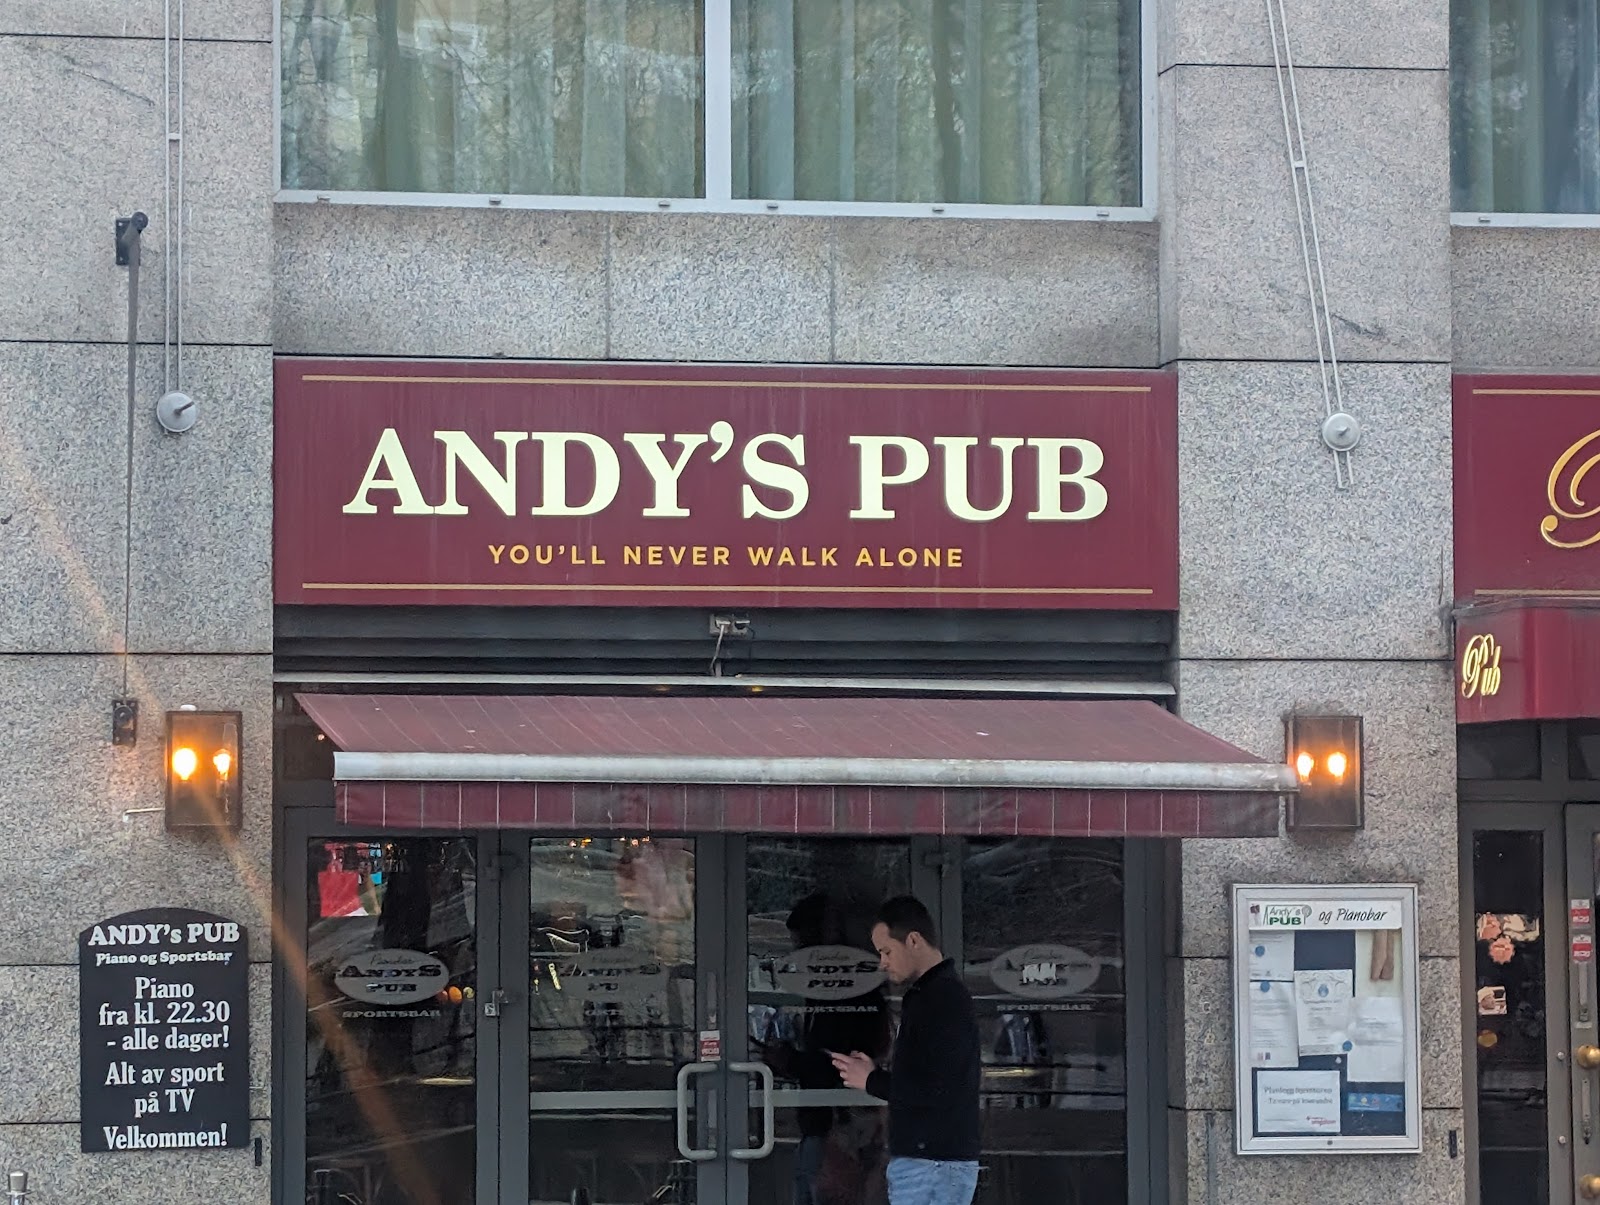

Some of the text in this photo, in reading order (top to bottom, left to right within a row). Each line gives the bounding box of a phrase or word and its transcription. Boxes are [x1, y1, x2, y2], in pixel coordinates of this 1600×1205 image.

[342, 420, 1110, 523] ANDY'S PUB
[488, 544, 964, 568] YOU'LL NEVER WALK ALONE
[1461, 633, 1501, 698] Pub
[1269, 916, 1302, 926] PUB
[1318, 907, 1388, 925] og Pianobar
[88, 922, 241, 946] ANDY's PUB
[96, 950, 233, 967] Piano og Sportsbar
[134, 976, 195, 1000] Piano
[98, 1000, 230, 1026] fra kl. 22.30
[122, 1028, 160, 1051] alle
[164, 1025, 230, 1052] dager!
[104, 1061, 225, 1089] Alt av sport
[134, 1088, 195, 1118] på TV
[102, 1122, 228, 1150] Velkommen!
